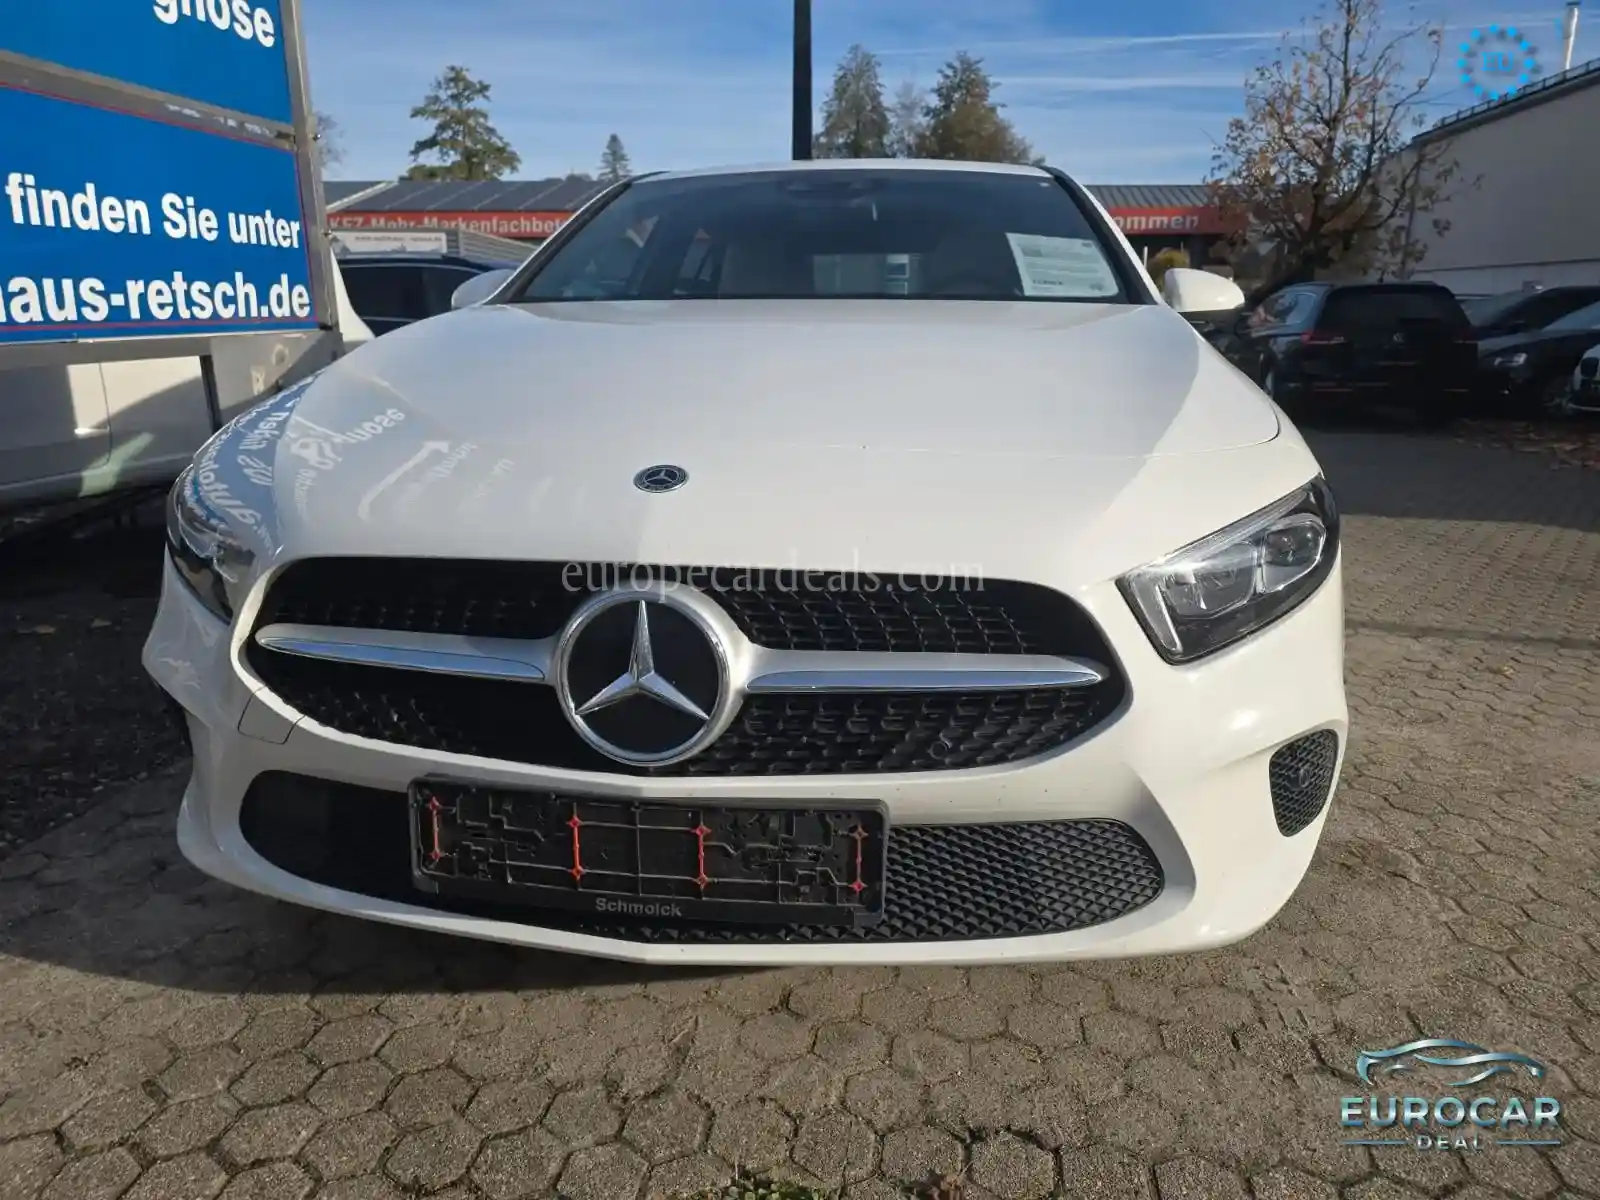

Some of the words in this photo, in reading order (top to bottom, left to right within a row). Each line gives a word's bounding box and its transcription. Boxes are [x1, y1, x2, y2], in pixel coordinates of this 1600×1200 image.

[5, 173, 151, 235] finden
[161, 193, 219, 241] Sie
[228, 209, 300, 249] unter
[0, 271, 310, 323] aus-retsch.de
[596, 898, 682, 917] Schmolck
